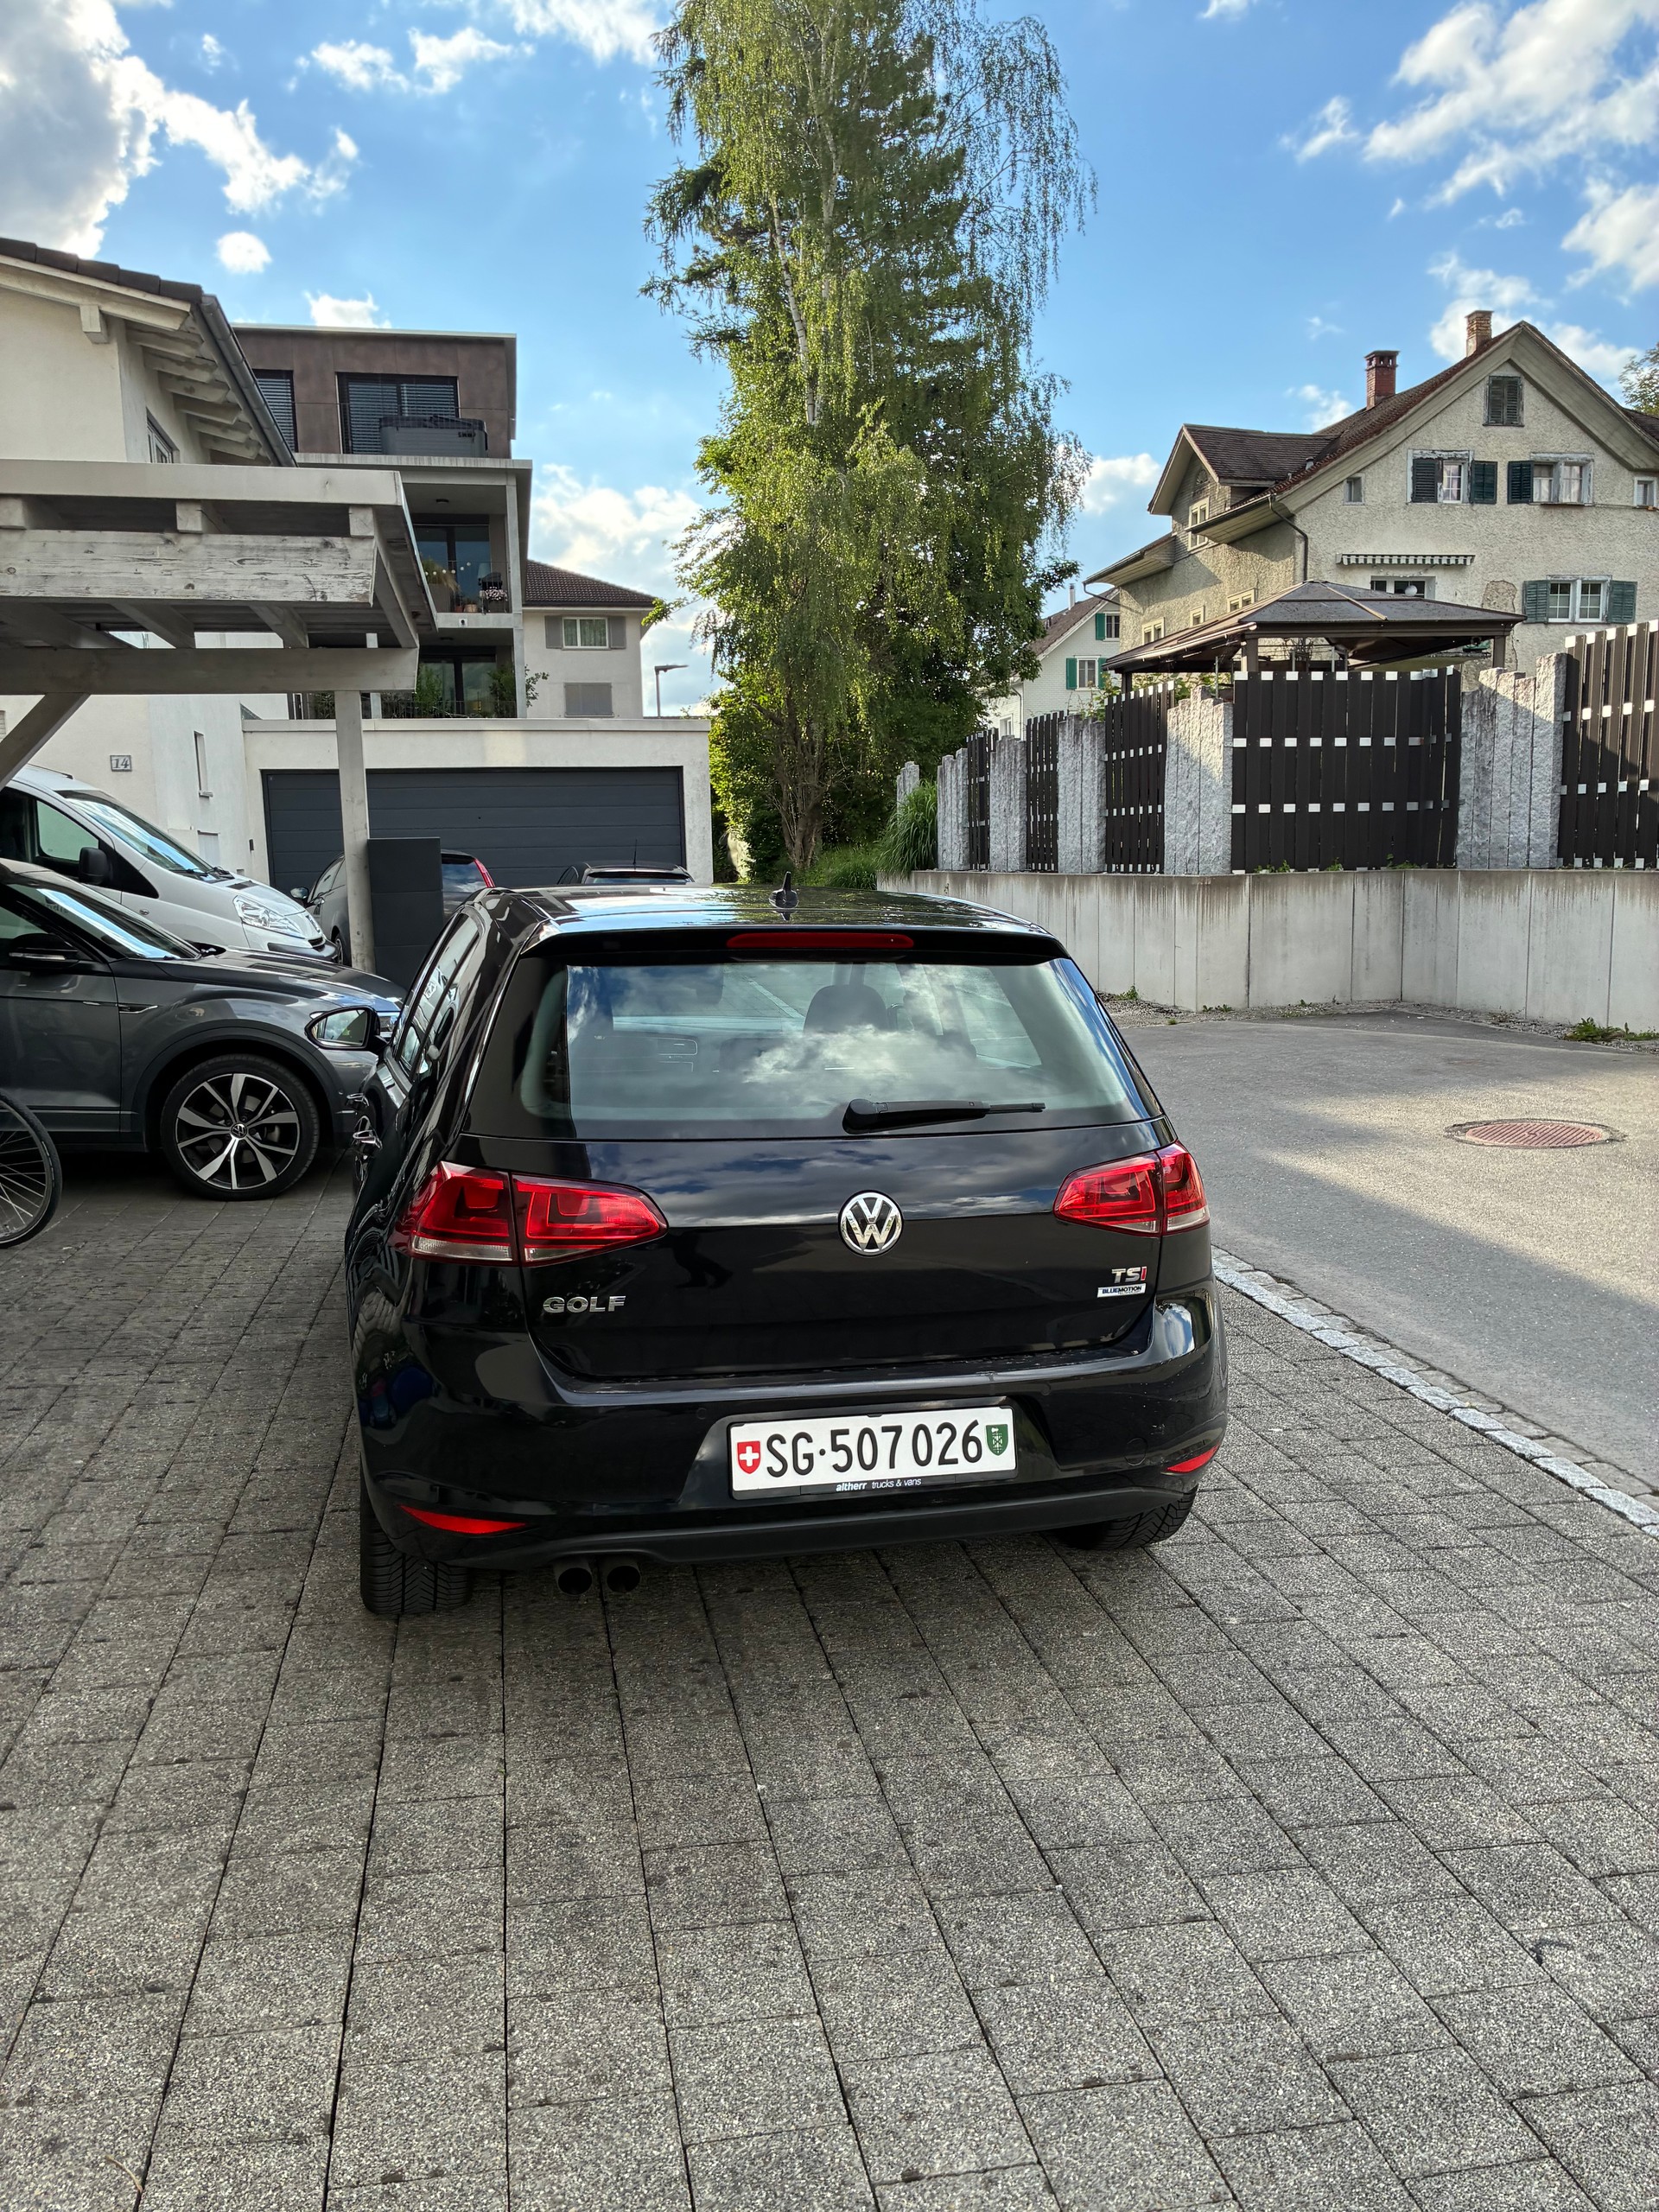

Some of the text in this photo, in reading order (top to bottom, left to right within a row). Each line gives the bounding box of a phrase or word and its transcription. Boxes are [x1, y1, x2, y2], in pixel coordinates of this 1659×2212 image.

[112, 758, 130, 769] 14
[841, 1192, 903, 1254] VW
[1102, 1286, 1142, 1294] BLUEMOTION
[543, 1295, 626, 1313] GOLF
[836, 1478, 922, 1492] altherr trucks & vans
